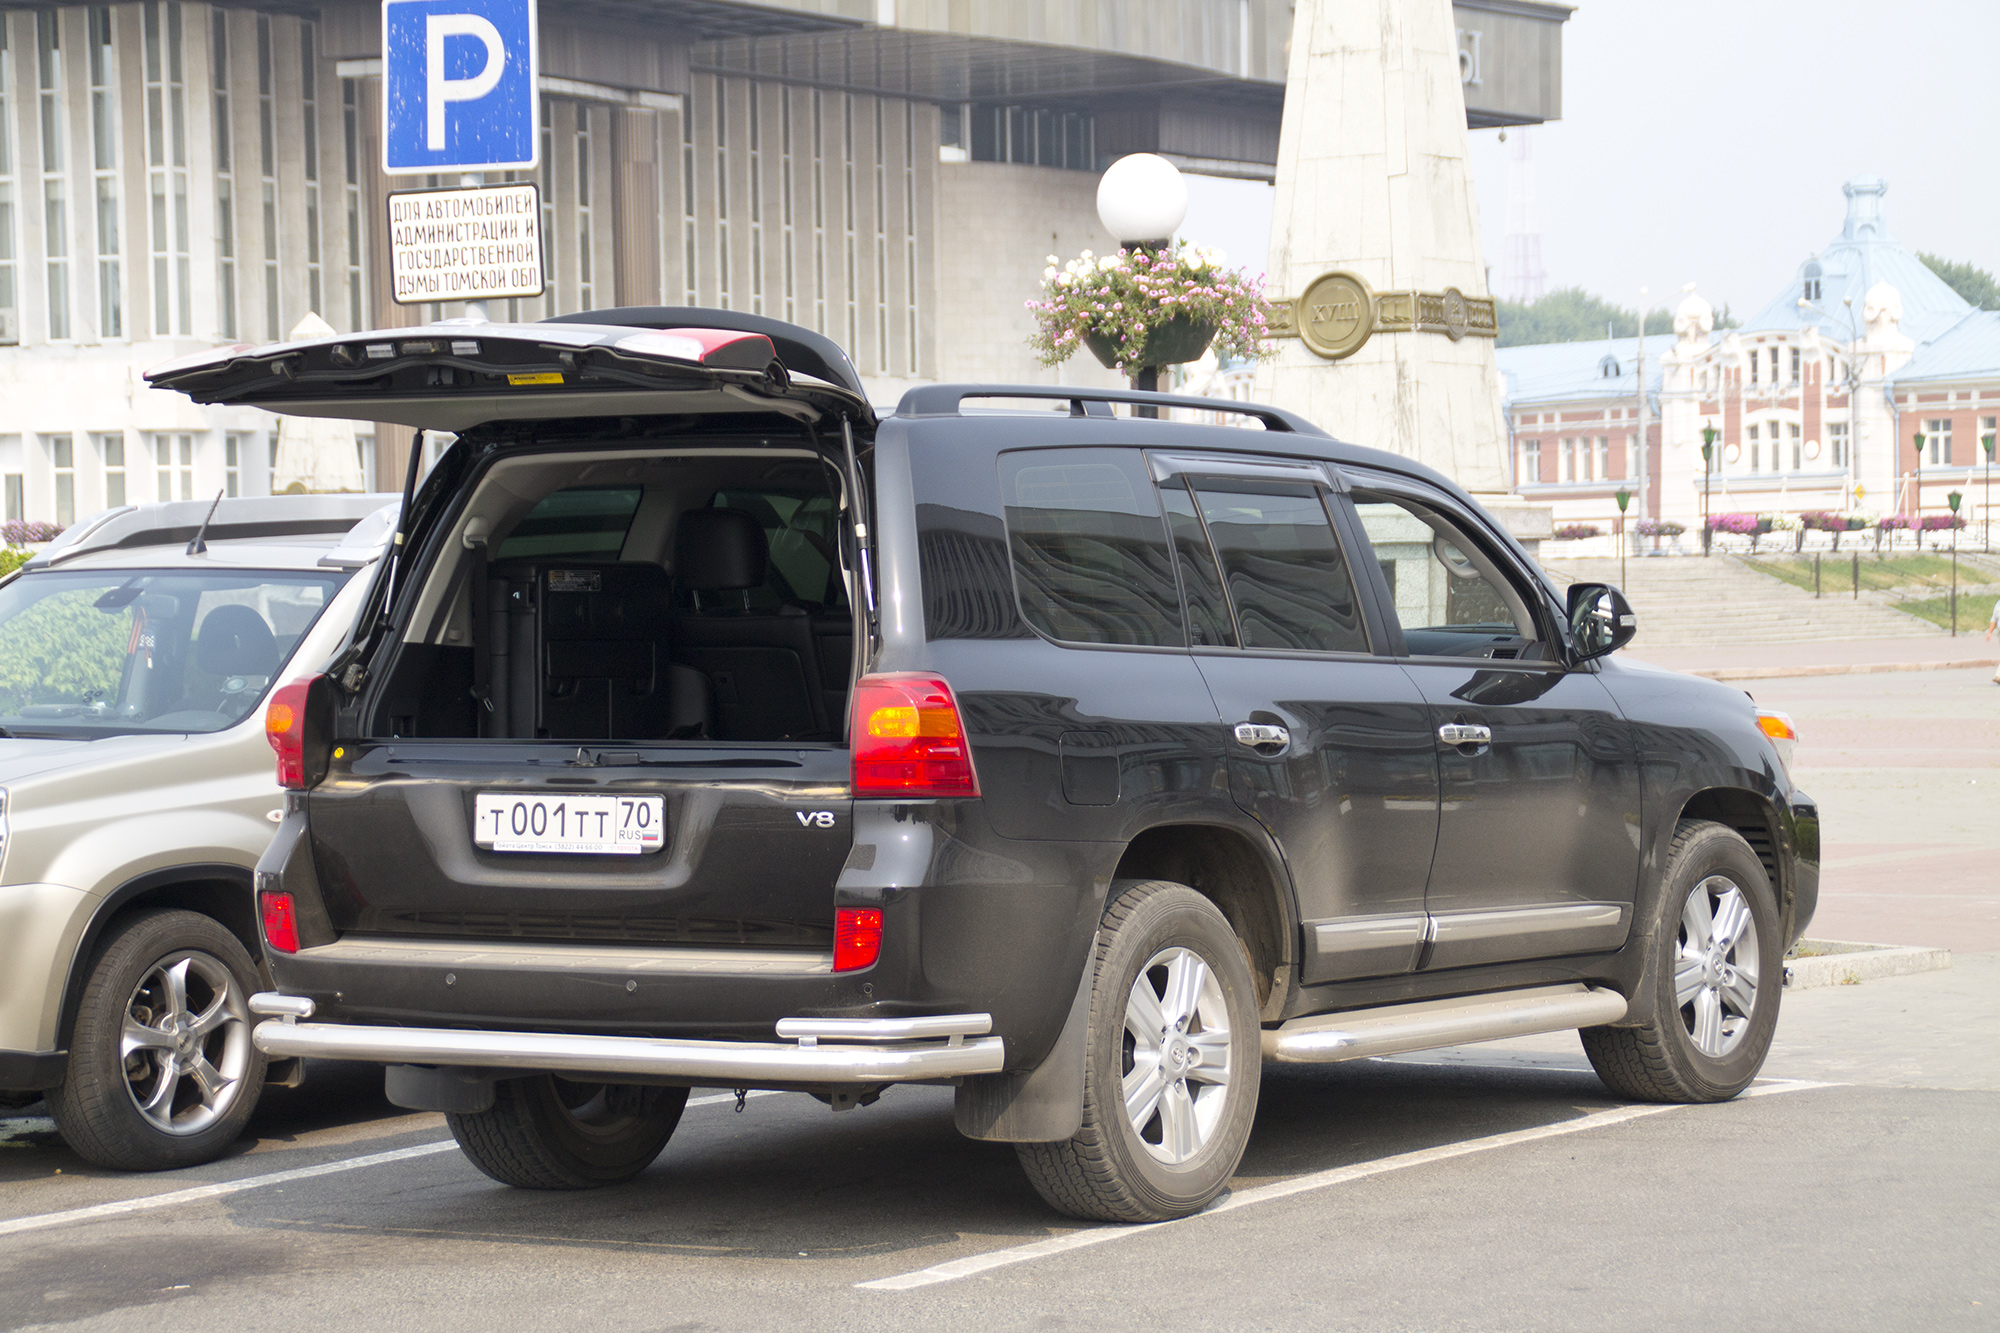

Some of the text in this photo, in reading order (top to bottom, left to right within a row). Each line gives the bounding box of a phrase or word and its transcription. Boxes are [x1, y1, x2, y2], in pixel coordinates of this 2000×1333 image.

[426, 13, 505, 150] P
[394, 191, 532, 222] ДЛЯ АВТОМОБИЛЕЙ
[395, 218, 534, 246] АДМИНИСТРАЦИИ И
[399, 242, 534, 270] ГОСУДАРСТВЕННОЙ
[399, 273, 439, 296] ДУМЫ
[443, 267, 506, 291] ТОМСКОЙ
[1311, 303, 1359, 323] XVIII
[621, 801, 651, 828] 70
[796, 811, 835, 828] V8
[618, 830, 641, 840] RUS
